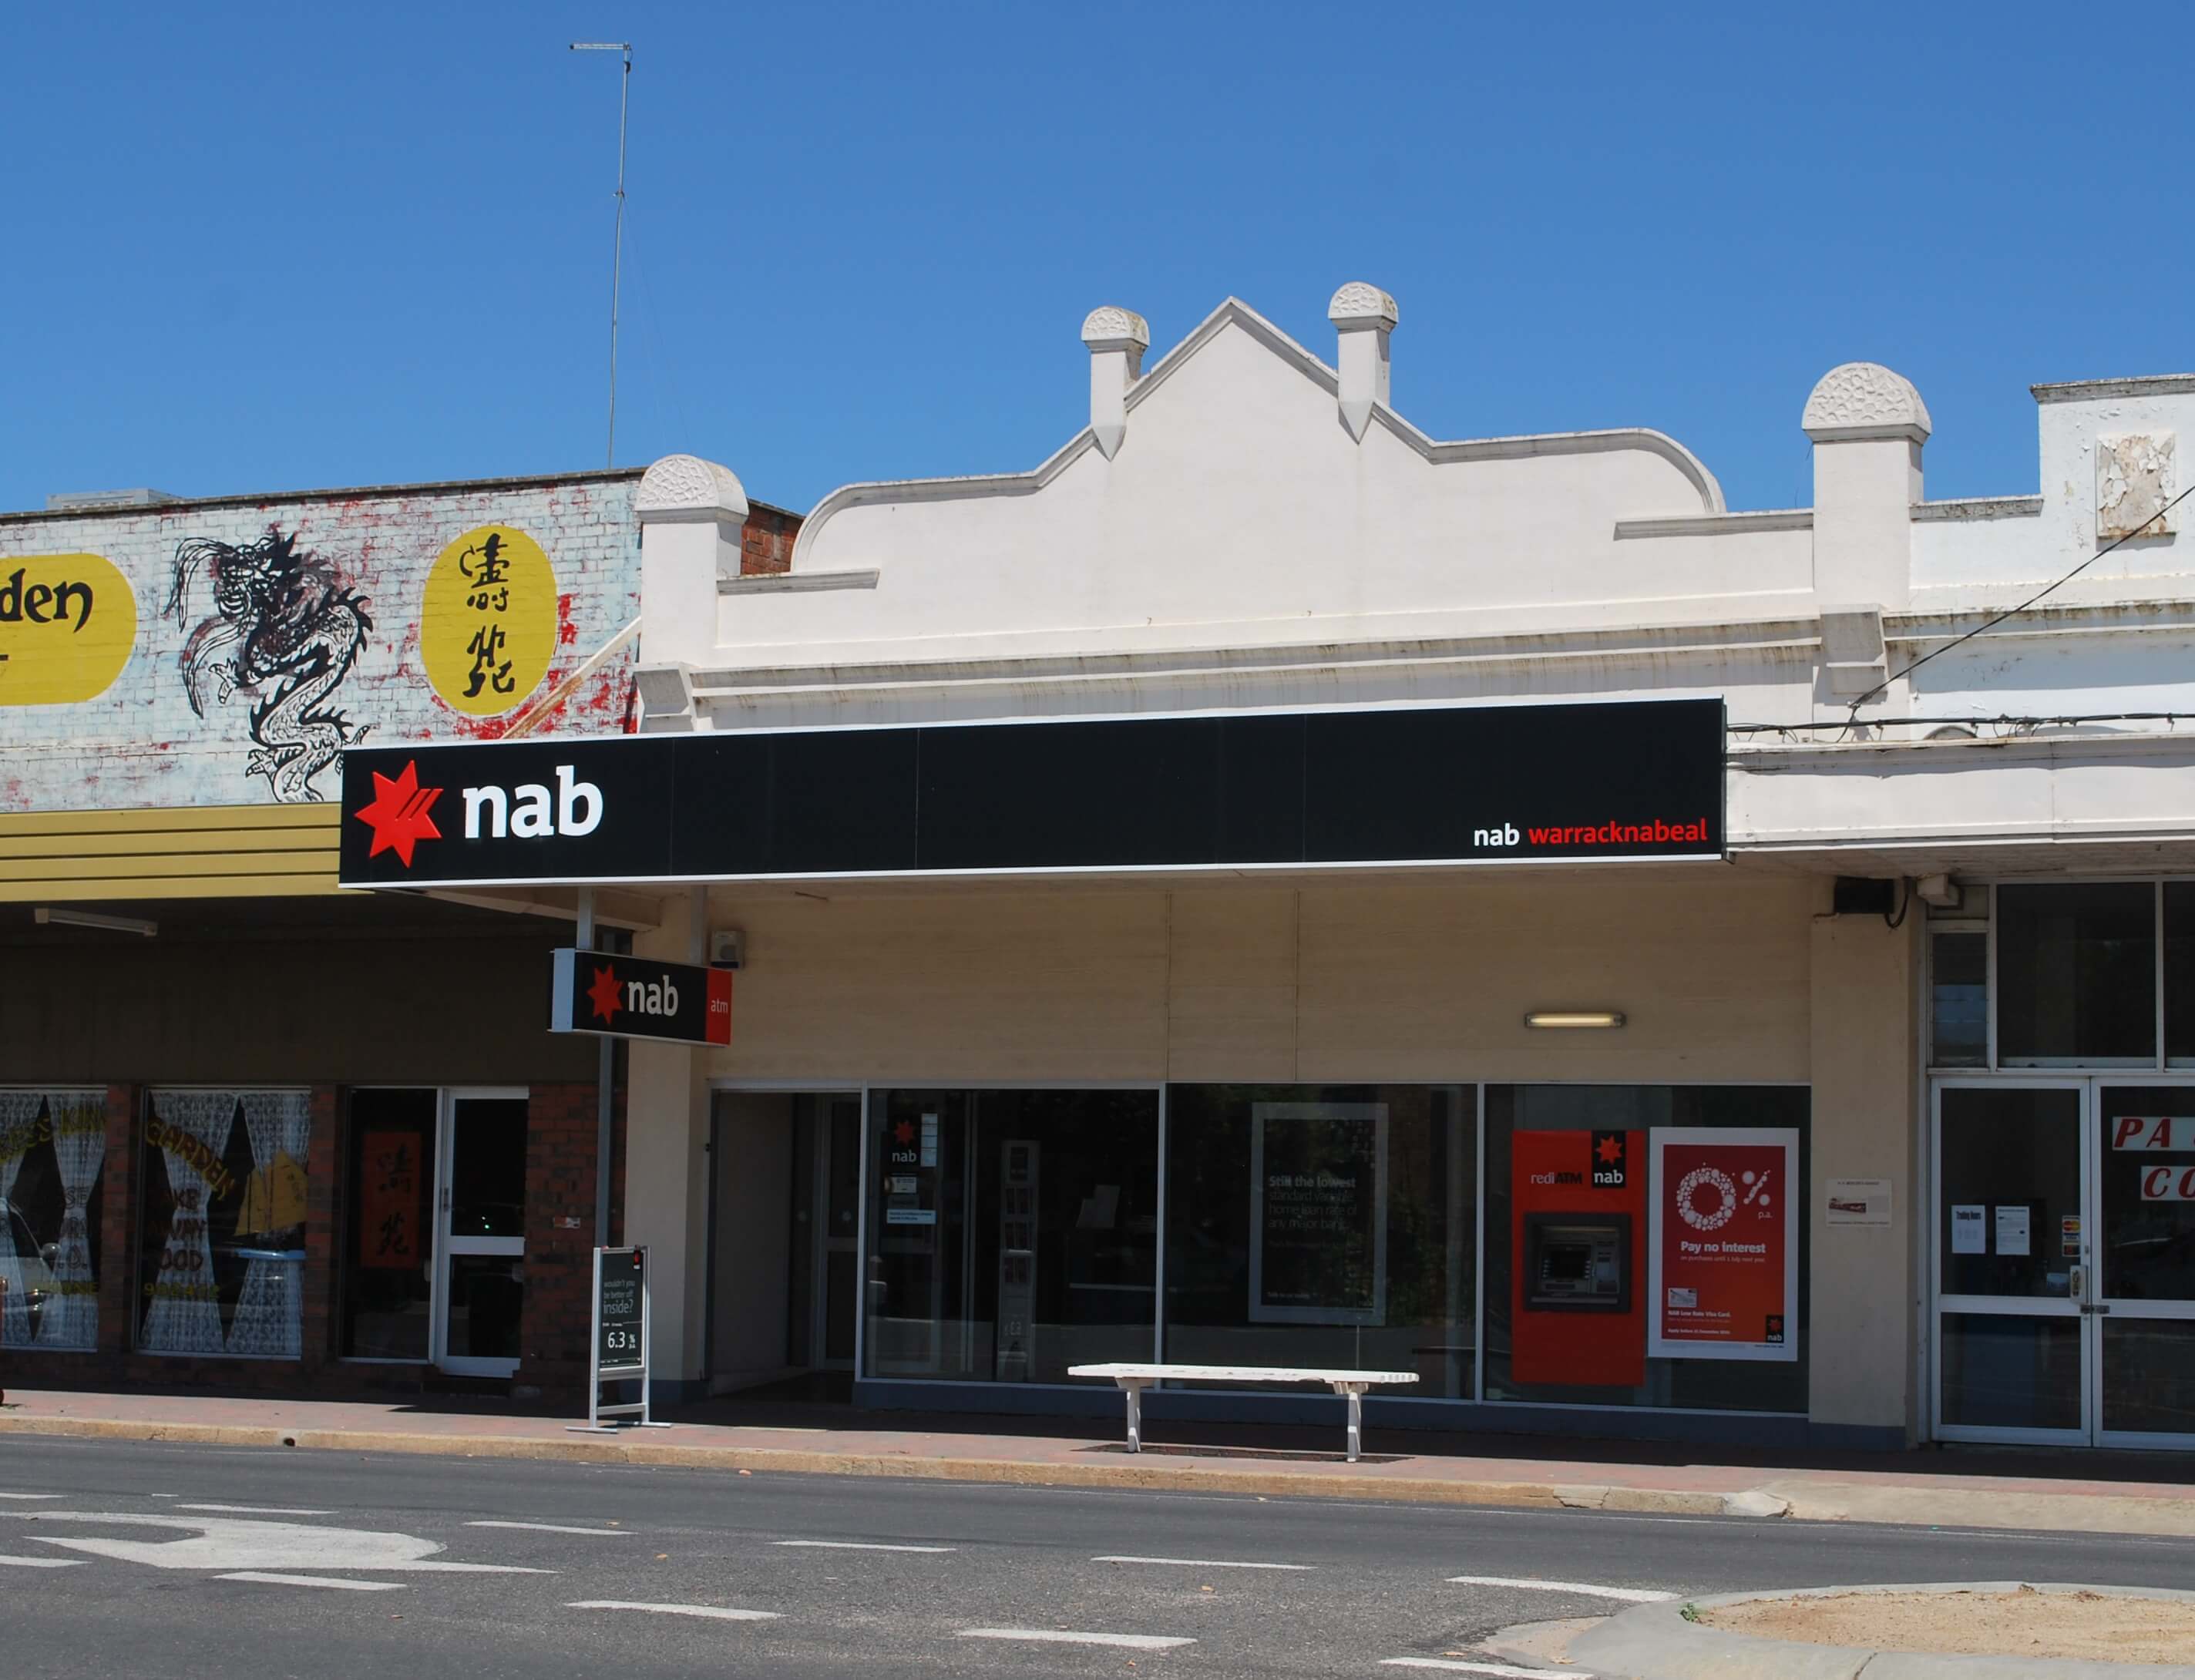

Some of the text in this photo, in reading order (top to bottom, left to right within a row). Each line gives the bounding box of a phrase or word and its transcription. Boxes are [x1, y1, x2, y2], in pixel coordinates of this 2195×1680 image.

[462, 764, 604, 839] nab
[1474, 818, 1709, 847] nab warracknabeal
[627, 974, 728, 1017] nab atm
[144, 1117, 235, 1201] GARDEN
[892, 1149, 918, 1163] nab
[1295, 1175, 1314, 1188] the
[1316, 1175, 1356, 1188] lowest
[1593, 1170, 1624, 1184] nab
[1757, 1210, 1773, 1220] p.a.
[1680, 1240, 1766, 1255] Pay no interest
[603, 1298, 634, 1315] inside?
[607, 1331, 626, 1349] 6.3
[1767, 1334, 1783, 1342] nab
